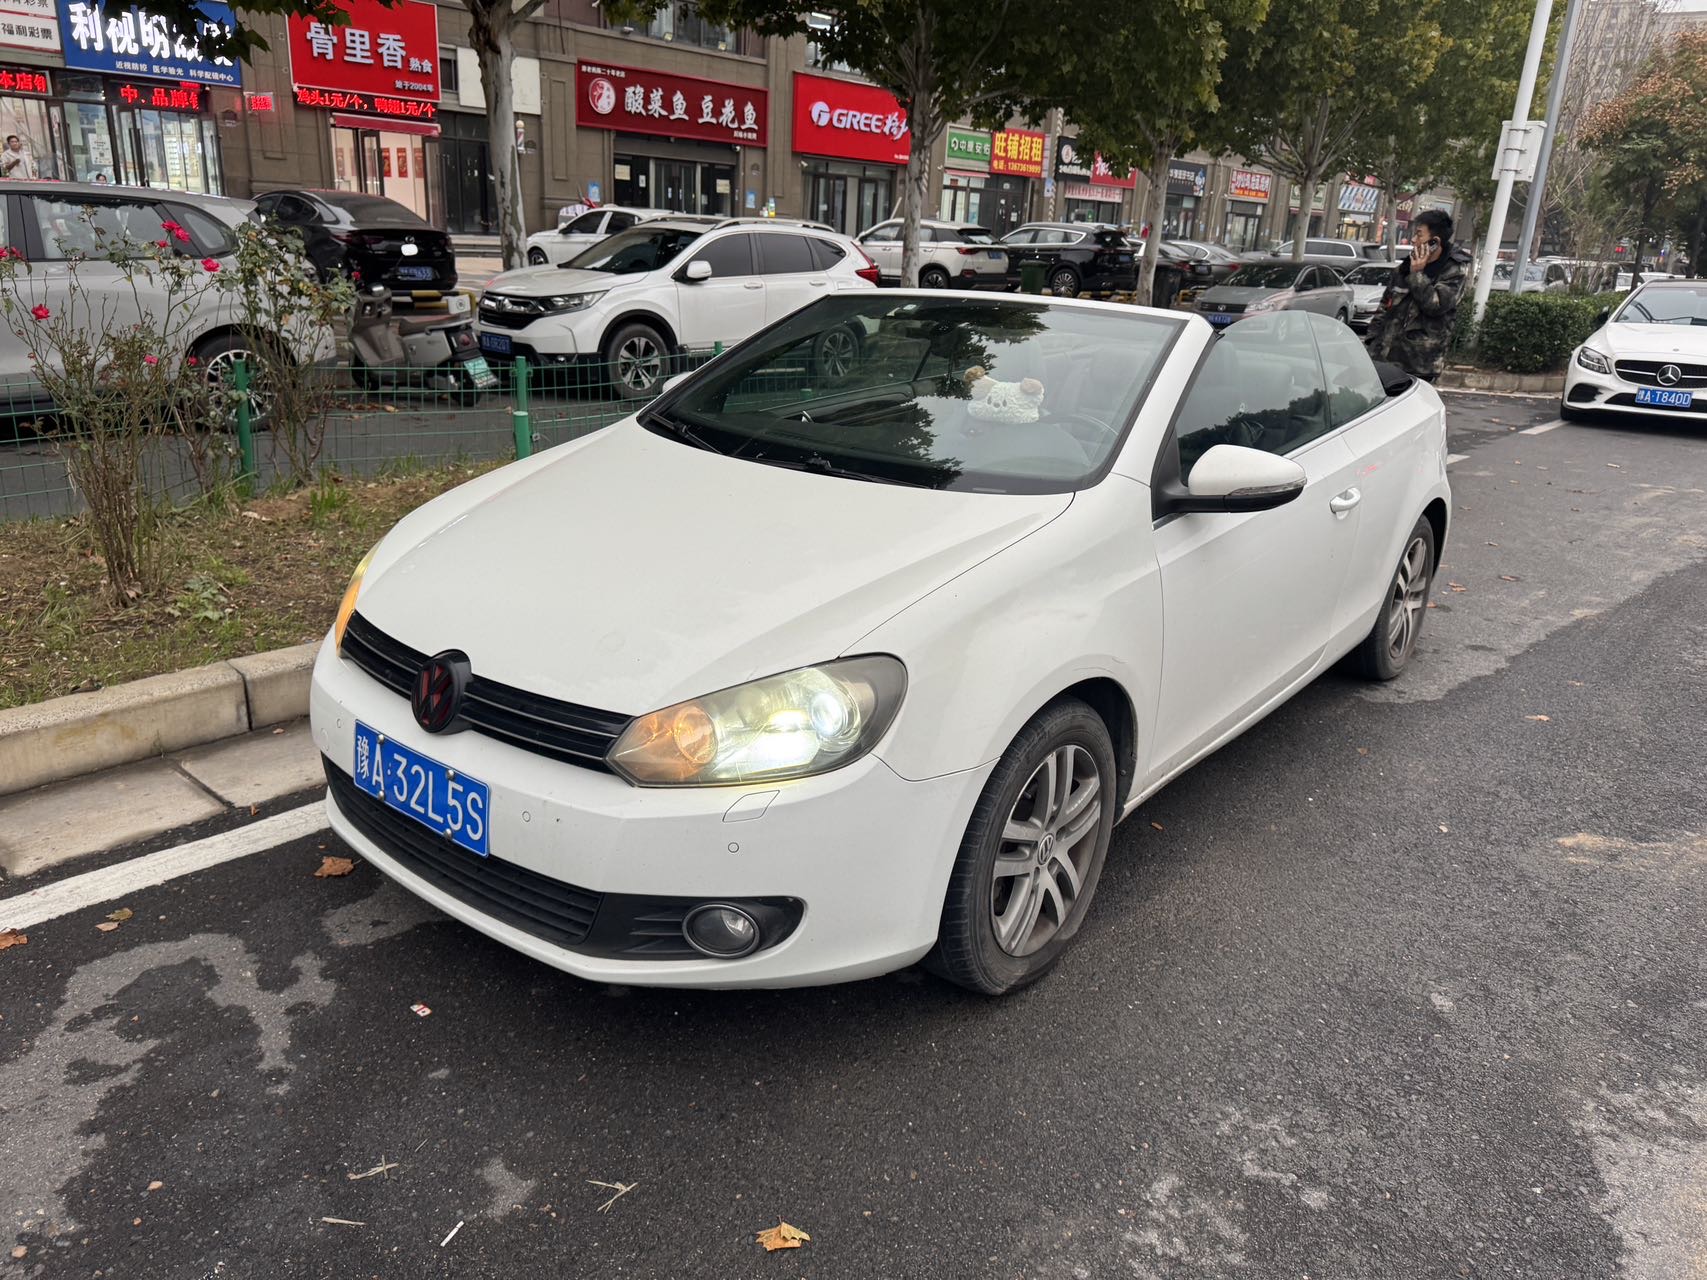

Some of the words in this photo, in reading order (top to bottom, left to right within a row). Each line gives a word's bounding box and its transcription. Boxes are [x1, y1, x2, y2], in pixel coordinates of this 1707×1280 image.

[1, 23, 53, 40] 福利彩票
[306, 22, 407, 70] 骨里香
[409, 57, 433, 74] 熟食
[395, 79, 434, 93] 始于2004年
[624, 84, 690, 121] 酸菜鱼
[698, 94, 759, 131] 豆花鱼
[832, 108, 884, 134] GREE
[994, 132, 1043, 162] 旺铺招租
